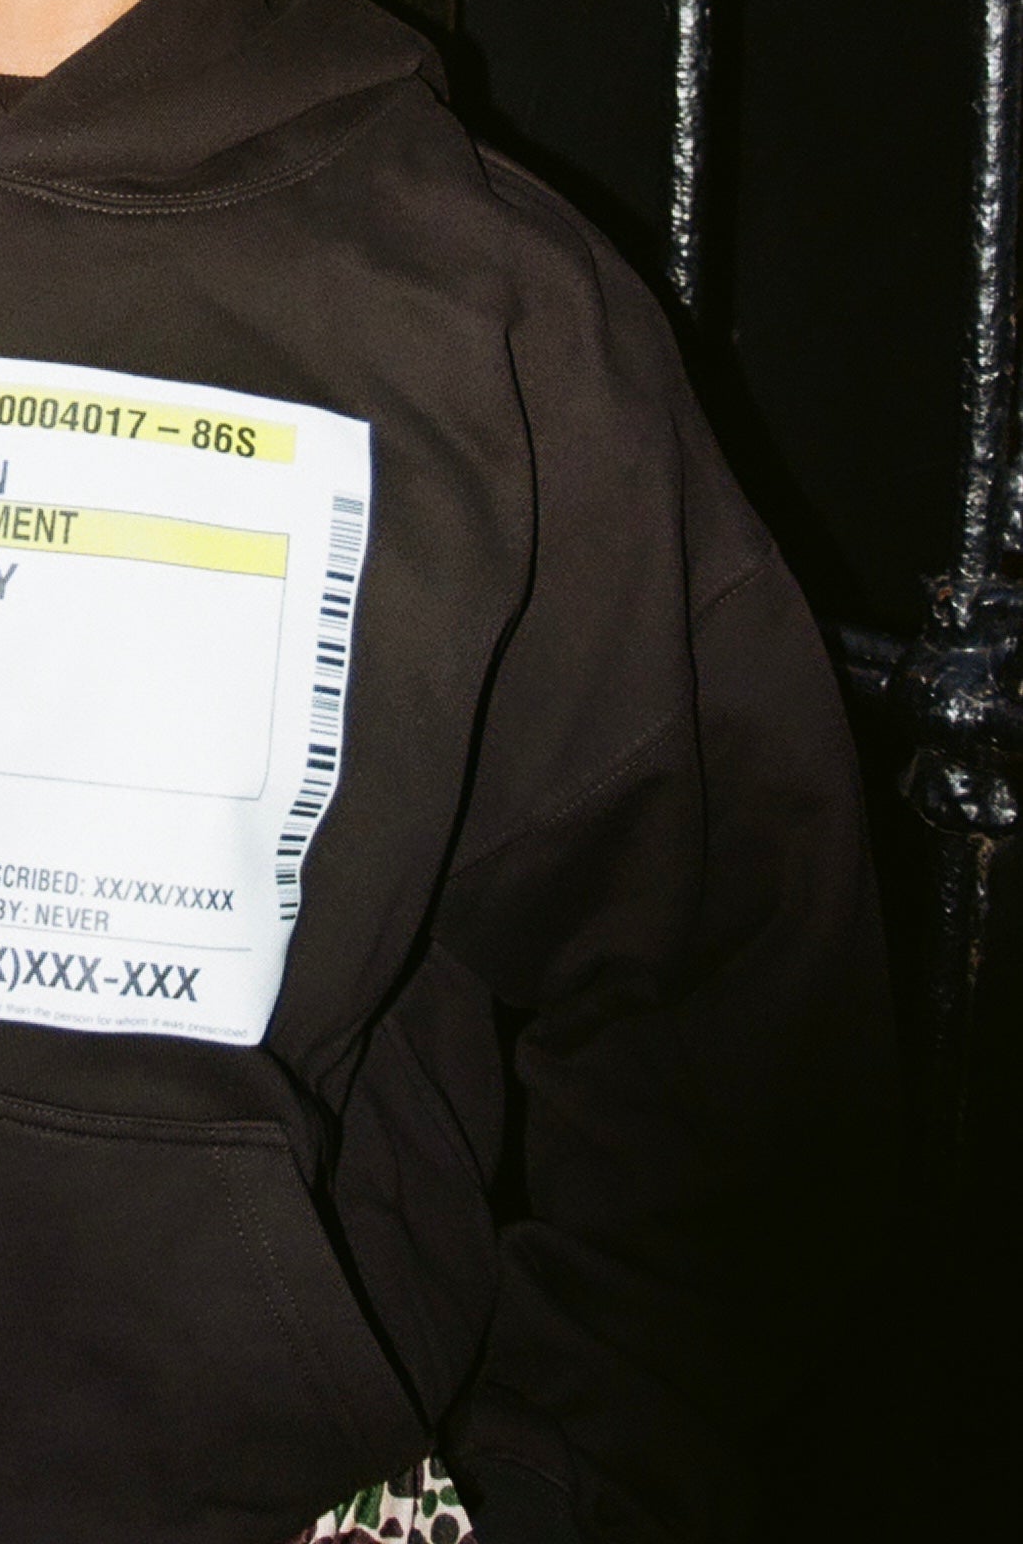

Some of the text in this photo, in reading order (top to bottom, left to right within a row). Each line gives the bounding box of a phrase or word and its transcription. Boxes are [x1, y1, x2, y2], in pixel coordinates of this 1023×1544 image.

[191, 419, 257, 458] 86S
[94, 876, 234, 912] XX/XX/XXXX
[35, 904, 110, 932] NEVER
